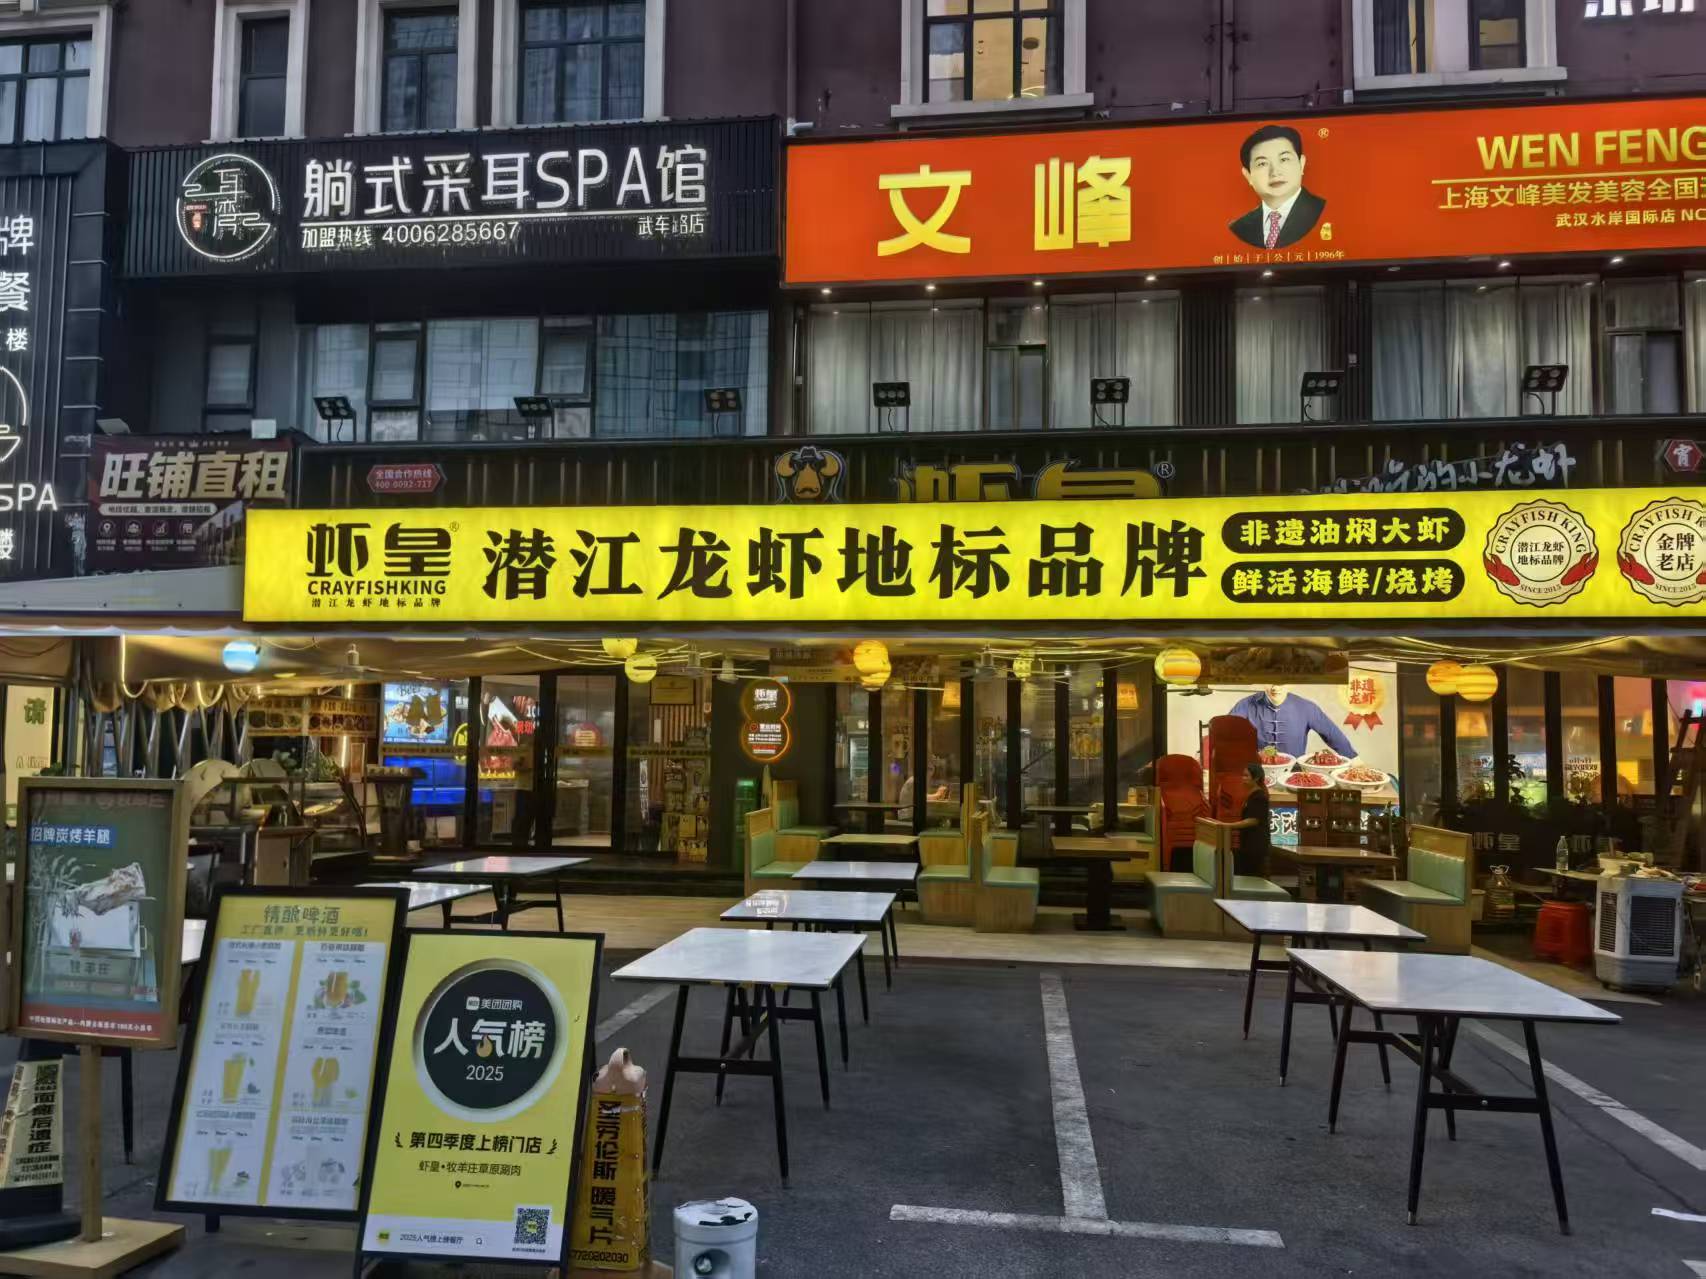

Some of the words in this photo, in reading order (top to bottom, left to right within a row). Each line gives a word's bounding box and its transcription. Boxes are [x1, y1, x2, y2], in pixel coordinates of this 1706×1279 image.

[1477, 132, 1579, 170] WEN
[1595, 125, 1706, 165] FENG
[303, 144, 707, 218] 躺式采耳SPA馆
[1438, 176, 1706, 209] 上海文峰美发美容全国
[878, 156, 1132, 257] 文峰
[1555, 208, 1675, 227] 武汉水岸国际店
[301, 227, 372, 249] 加盟热线
[382, 221, 519, 247] 4006285667
[6, 328, 28, 351] 楼
[100, 450, 288, 499] 旺铺直租
[1240, 515, 1450, 547] 非遗油焖大虾
[1655, 532, 1696, 551] 金牌
[306, 522, 451, 577] 虾皇
[482, 519, 1208, 601] 潜江龙虾地标品牌
[1517, 541, 1565, 553] 潜江龙虾
[1517, 554, 1565, 566] 地标品牌
[1655, 553, 1695, 572] 老店
[307, 579, 447, 596] CRAYFISHKING
[1232, 566, 1454, 597] 鲜活海鲜/烧烤
[311, 597, 442, 608] 潜江龙虾地标品牌
[433, 1017, 546, 1059] 人气榜
[466, 1064, 505, 1082] 2025
[410, 1131, 543, 1155] 第四季度上榜门店
